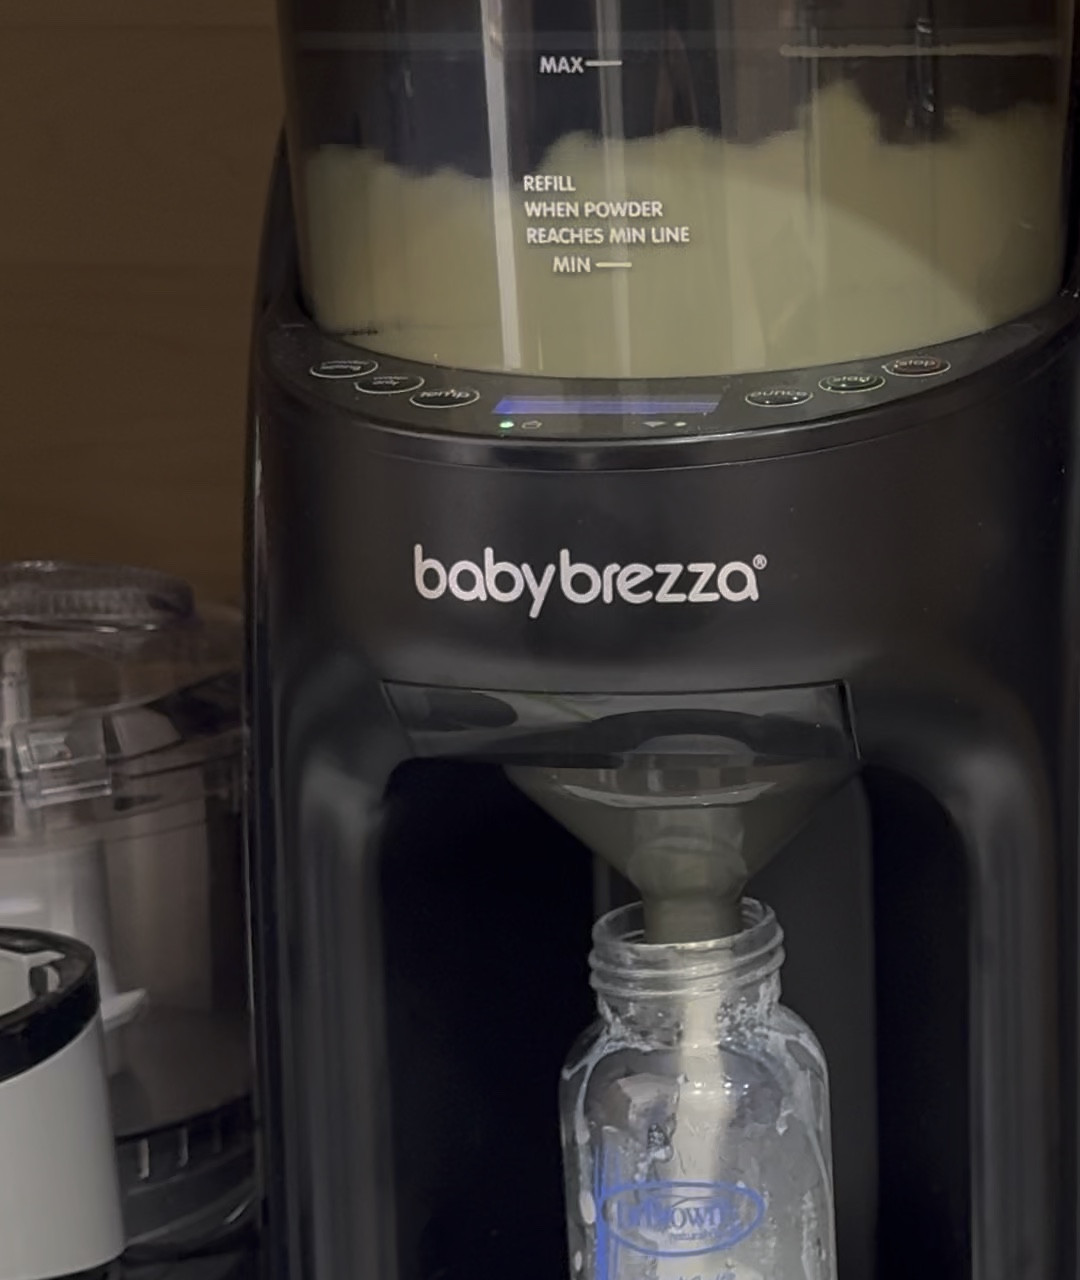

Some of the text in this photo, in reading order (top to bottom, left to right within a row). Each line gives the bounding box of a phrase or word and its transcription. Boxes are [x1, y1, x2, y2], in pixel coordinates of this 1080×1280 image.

[539, 56, 585, 74] MAX
[523, 175, 577, 192] REFILL
[524, 201, 664, 218] WHEN POWDER
[526, 226, 691, 244] REACHES MIN LINE
[552, 256, 592, 273] MIN
